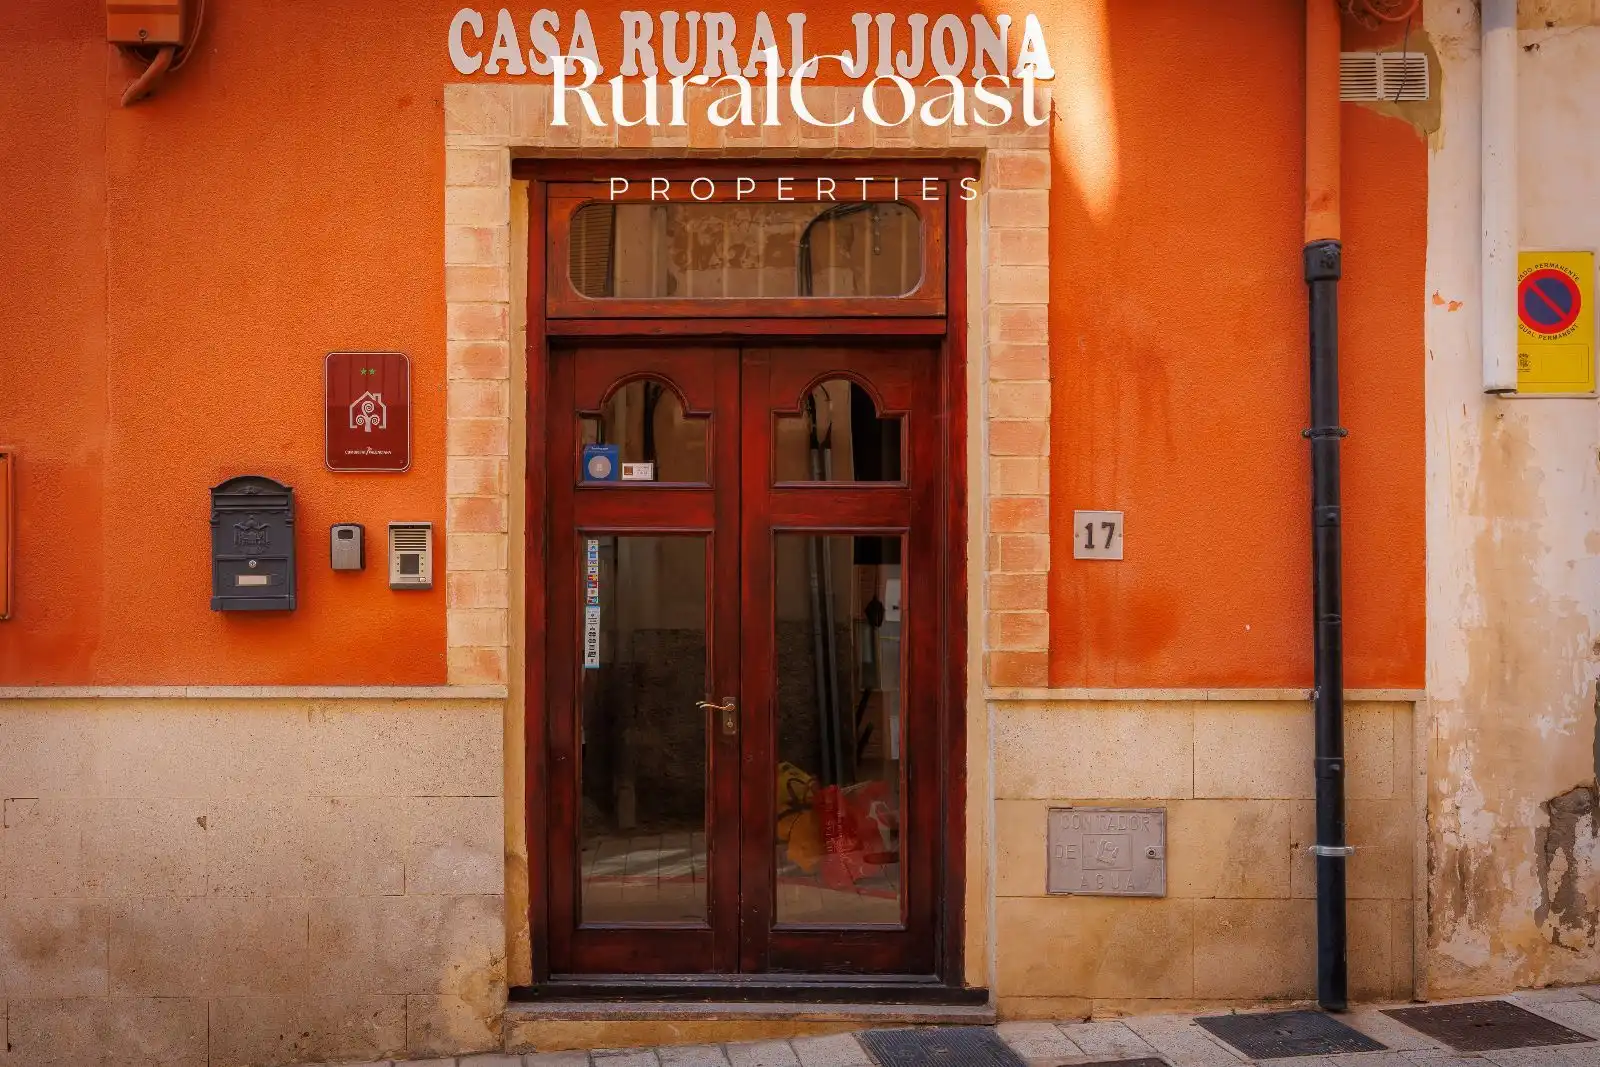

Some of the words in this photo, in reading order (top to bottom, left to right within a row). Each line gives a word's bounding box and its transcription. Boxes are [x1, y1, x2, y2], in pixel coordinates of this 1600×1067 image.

[448, 8, 603, 76] CASA
[620, 10, 819, 79] RURAL
[841, 13, 1055, 80] JIJONA
[1535, 262, 1580, 281] PERMANENTE
[1084, 521, 1116, 549] 17
[1060, 811, 1151, 832] CONTADOR
[1055, 844, 1077, 860] DE
